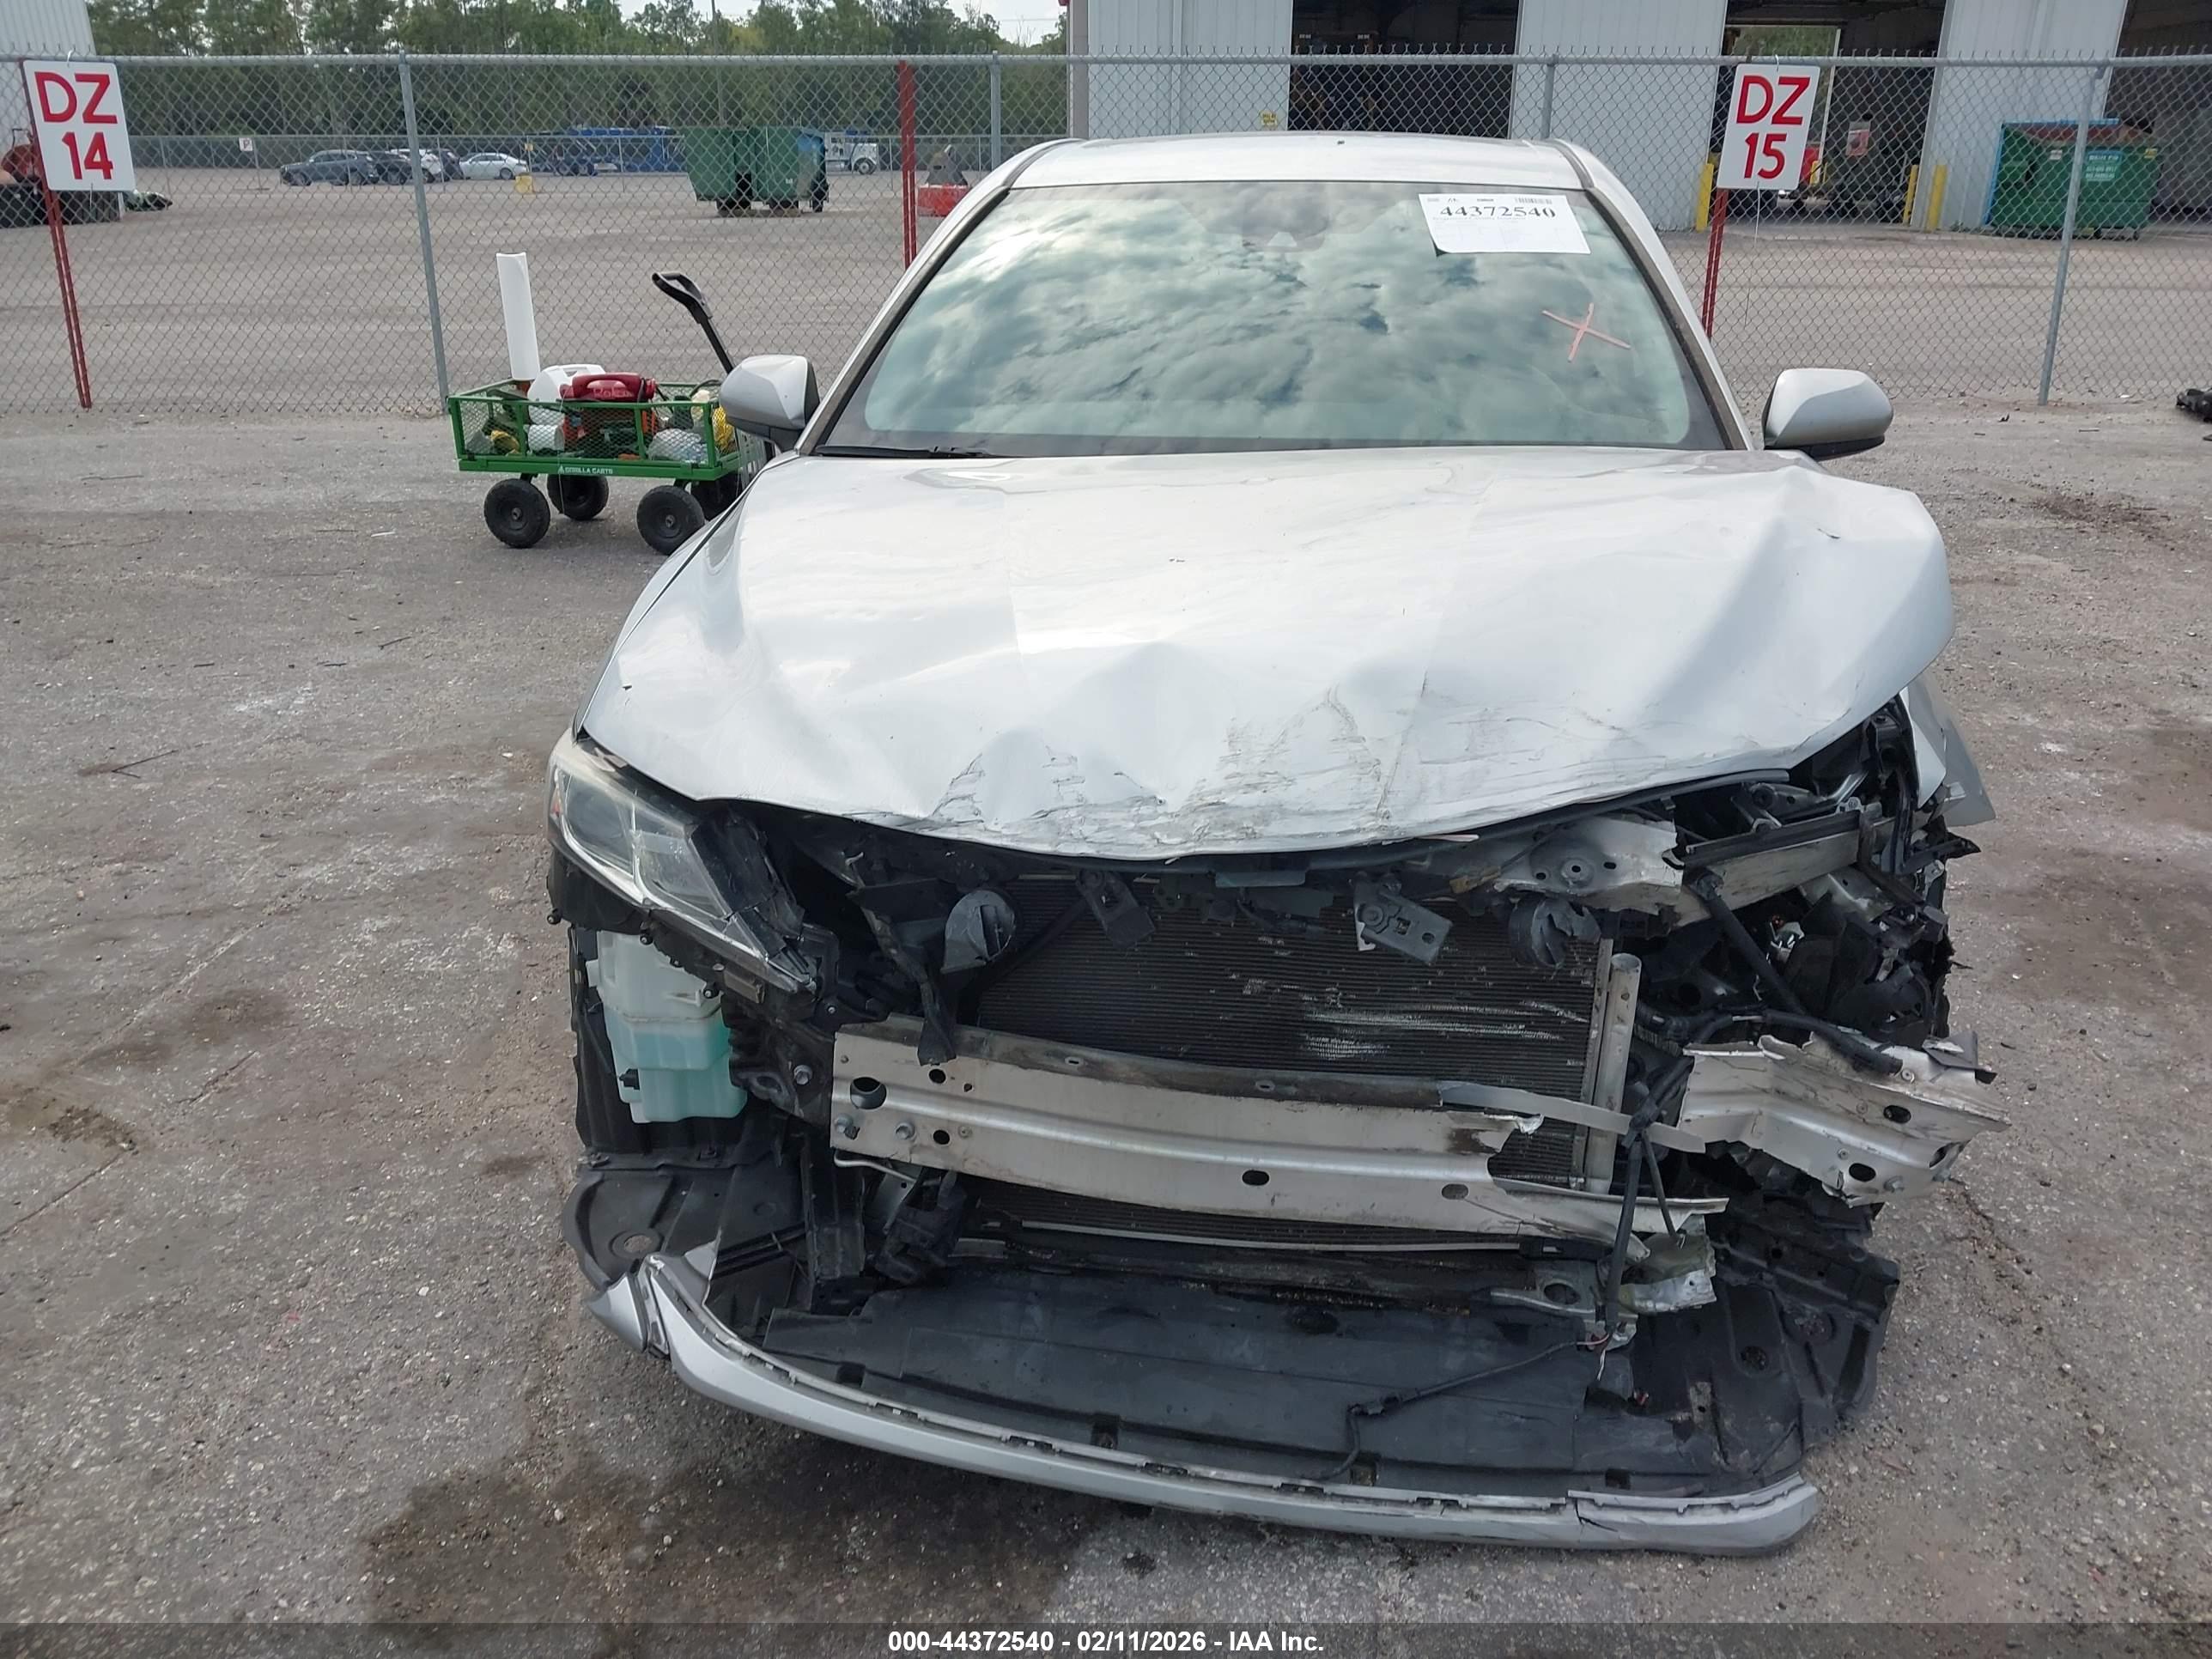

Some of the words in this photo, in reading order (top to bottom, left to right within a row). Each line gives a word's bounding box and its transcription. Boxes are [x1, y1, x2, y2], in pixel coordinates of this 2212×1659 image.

[34, 71, 118, 124] DZ
[1736, 76, 1810, 125] DZ
[61, 131, 113, 179] 14
[1744, 132, 1787, 179] 15
[1439, 205, 1557, 217] 44372540
